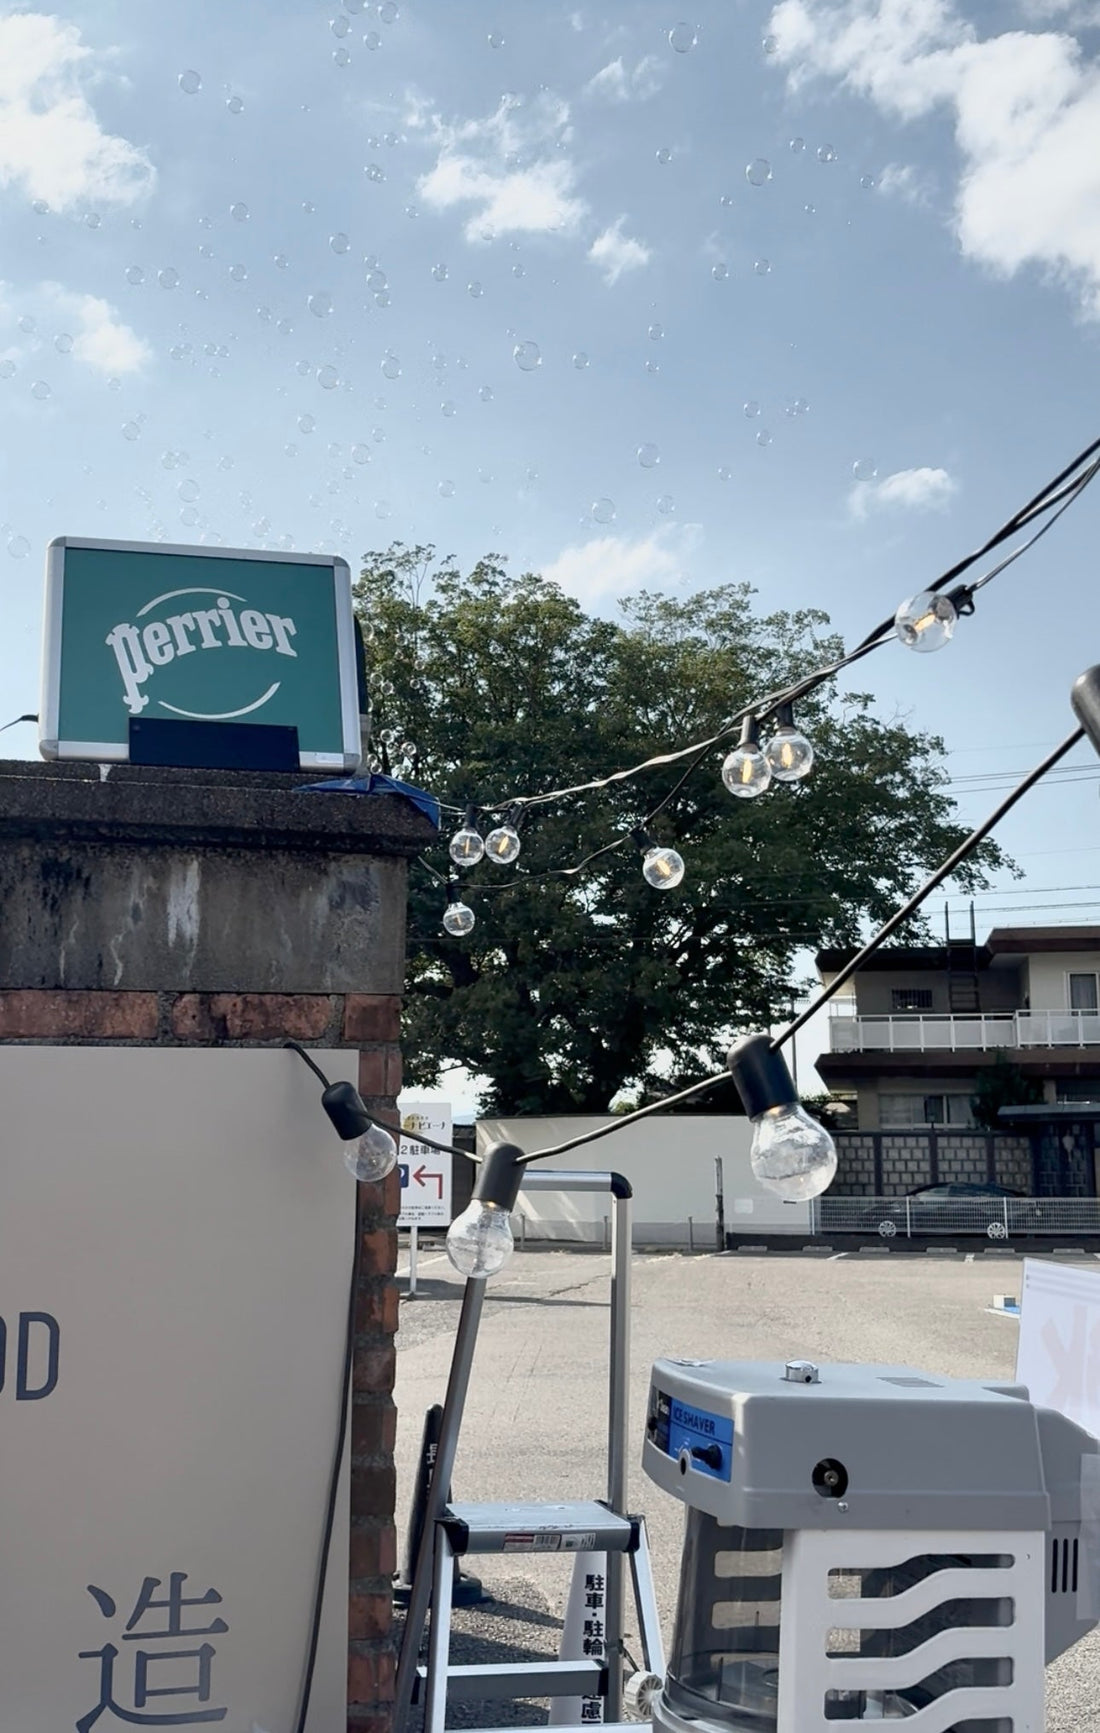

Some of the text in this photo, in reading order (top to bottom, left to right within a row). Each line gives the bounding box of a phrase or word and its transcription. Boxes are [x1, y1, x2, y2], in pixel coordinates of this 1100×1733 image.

[105, 597, 298, 714] perrier
[673, 1406, 682, 1422] ICE
[683, 1411, 715, 1435] SHAVER
[75, 1572, 229, 1733] 造
